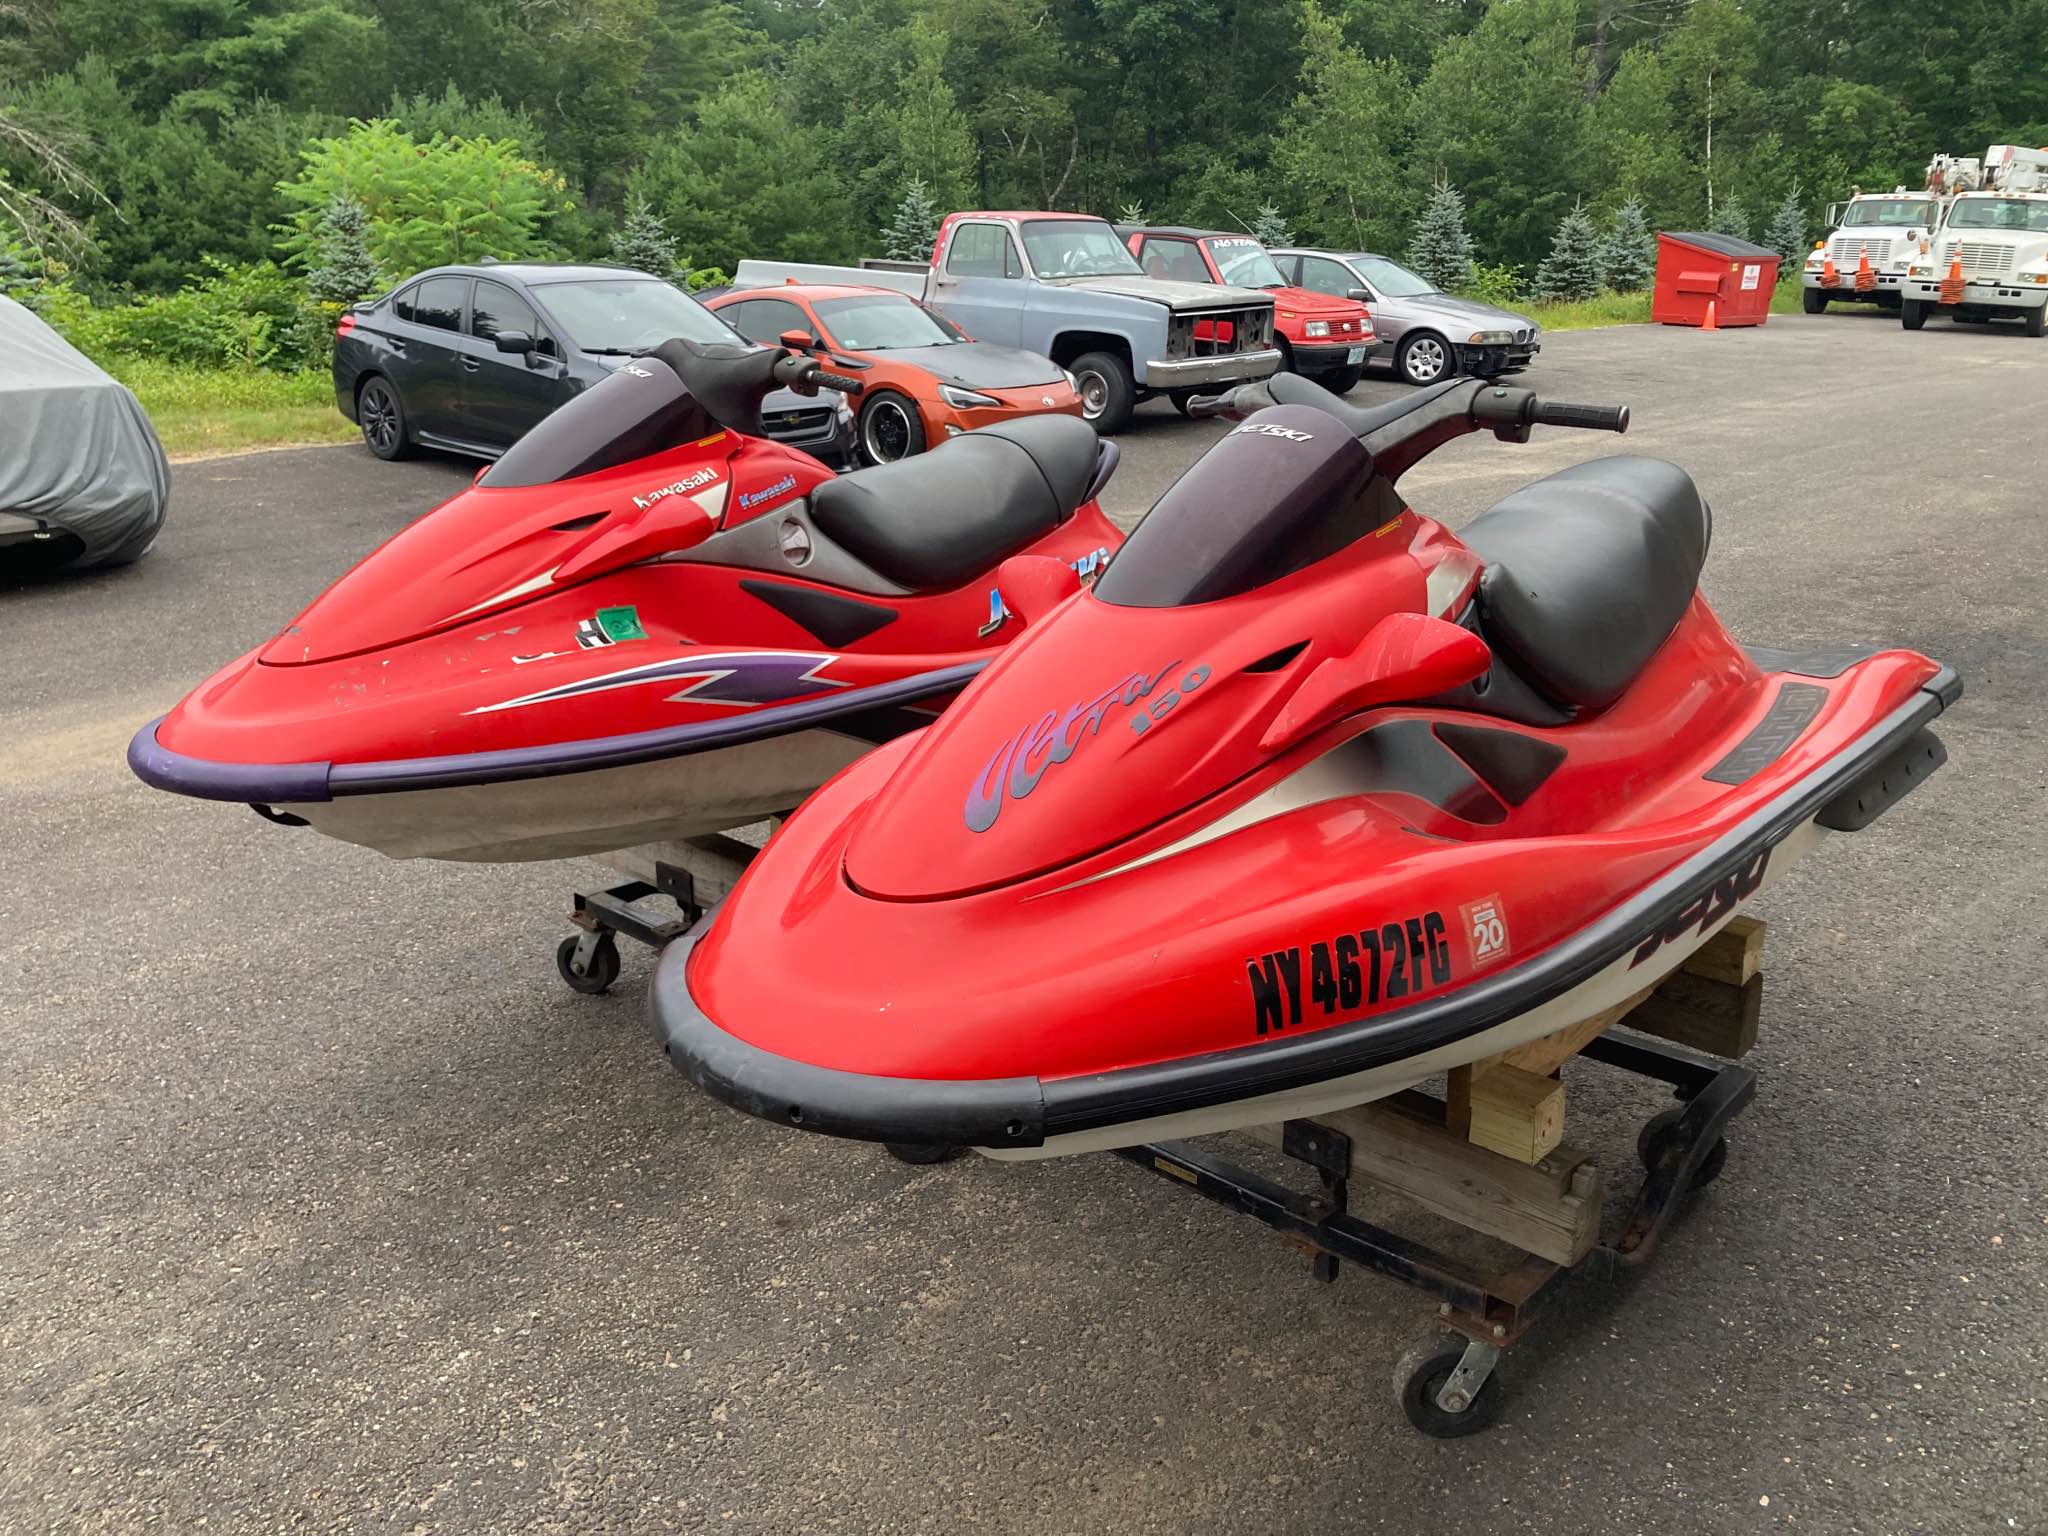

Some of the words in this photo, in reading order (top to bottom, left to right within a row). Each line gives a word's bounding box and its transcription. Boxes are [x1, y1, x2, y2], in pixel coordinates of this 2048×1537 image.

[632, 466, 719, 510] Kawasaki
[738, 474, 797, 509] Kawasaki
[1130, 664, 1212, 736] 150
[1473, 918, 1505, 956] 20
[1246, 947, 1303, 1035] NY
